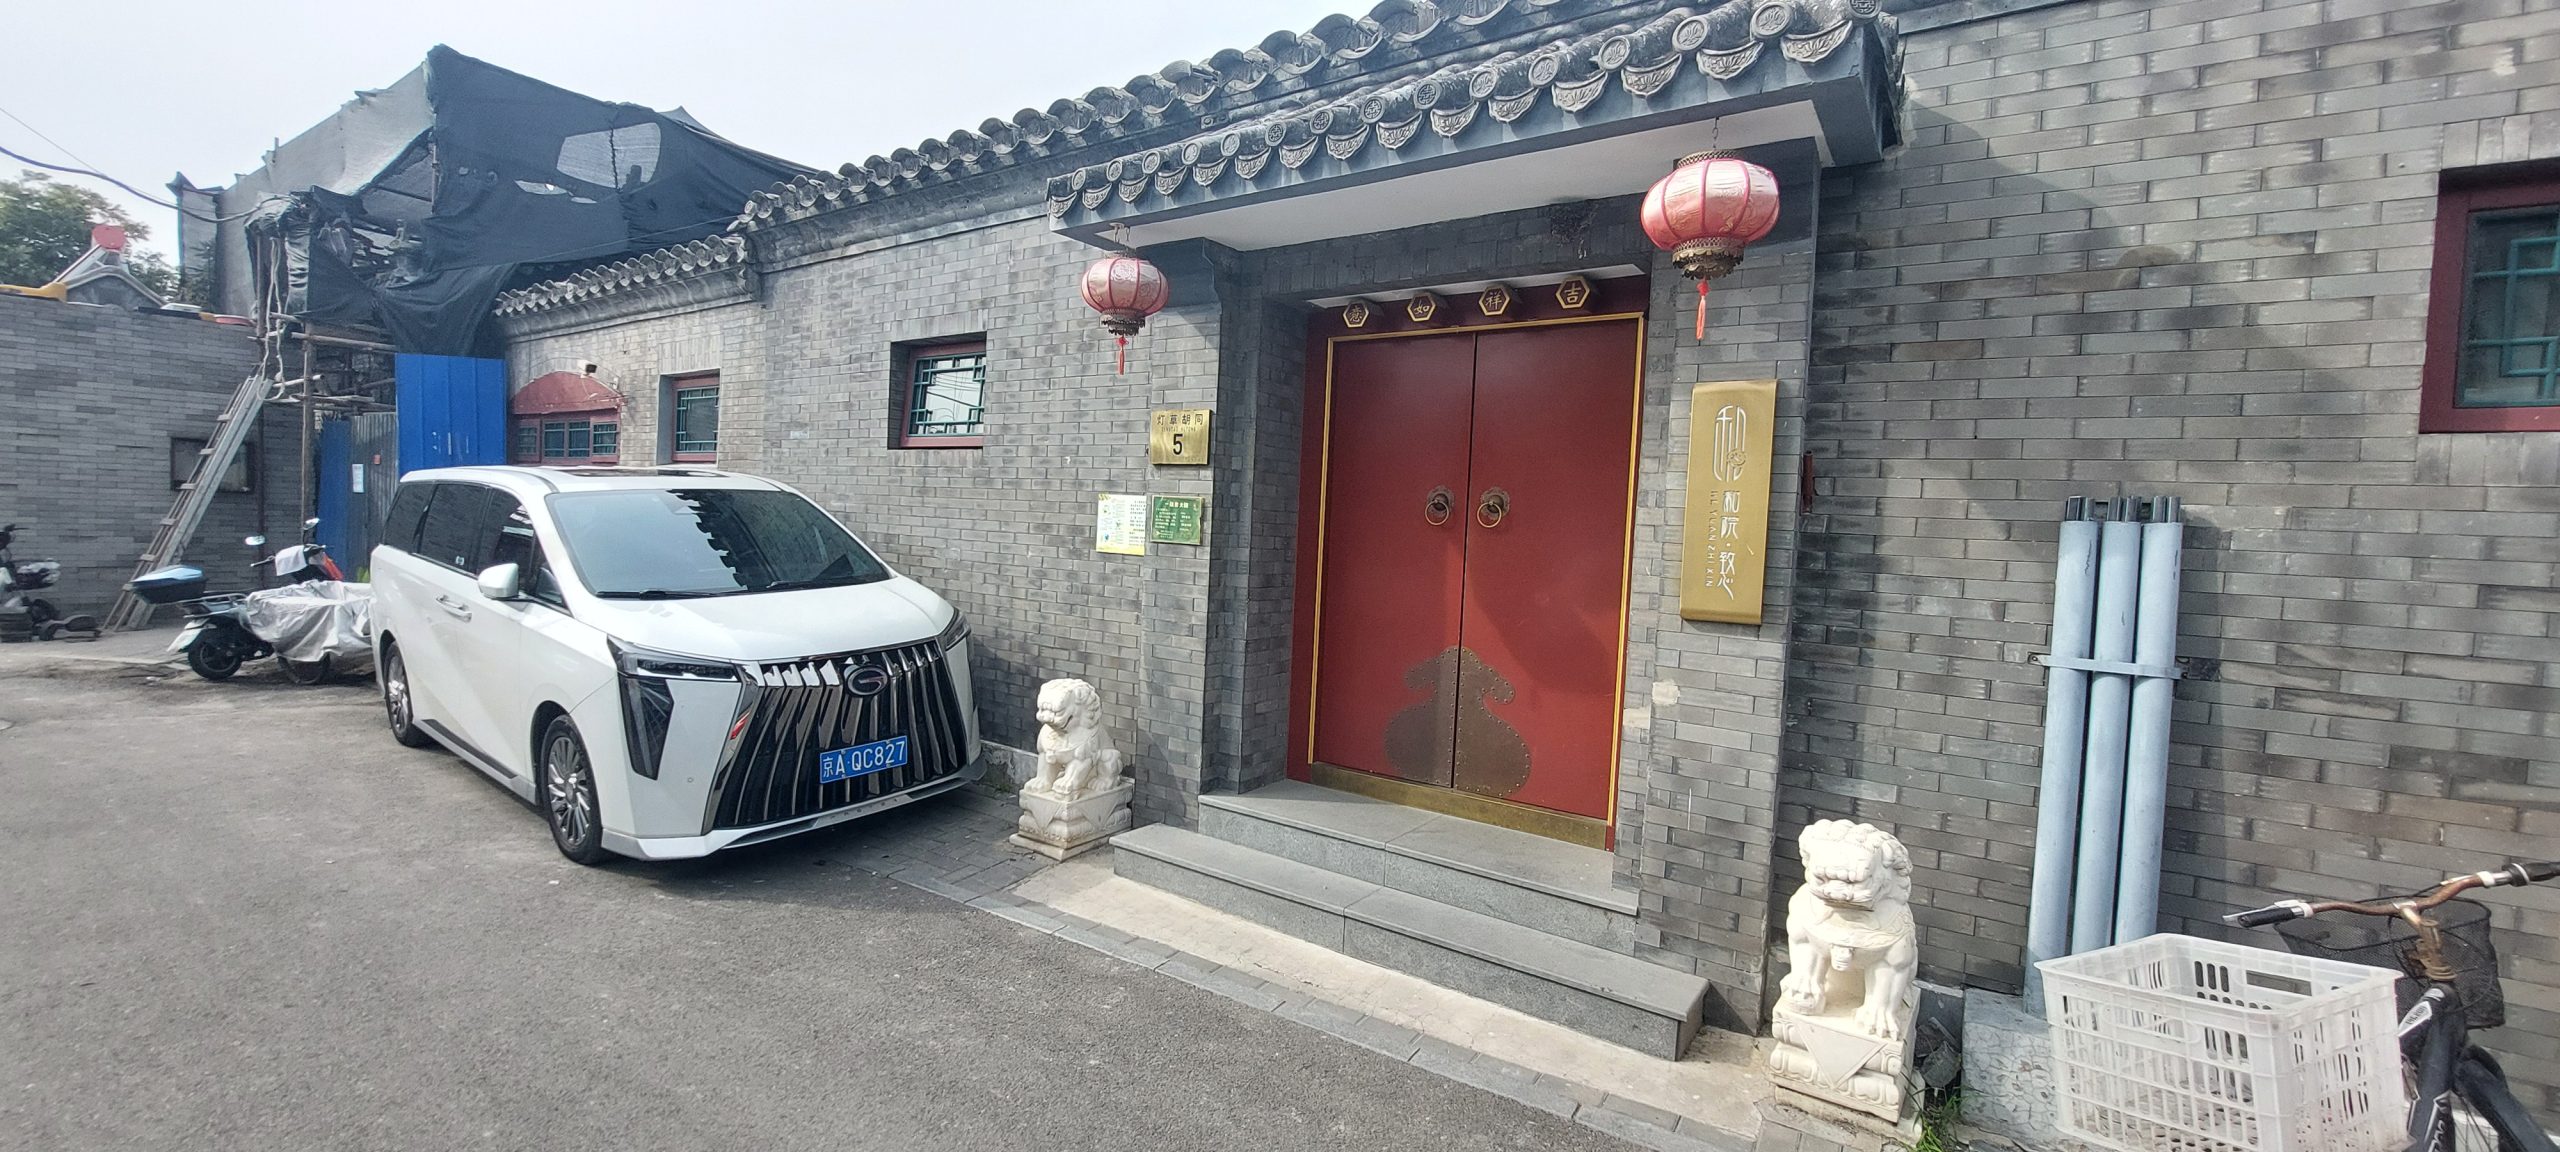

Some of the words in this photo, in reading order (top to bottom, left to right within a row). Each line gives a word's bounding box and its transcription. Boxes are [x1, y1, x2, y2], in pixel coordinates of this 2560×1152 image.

[1485, 291, 1502, 310] 祥
[1564, 282, 1582, 303] 吉
[1349, 305, 1363, 322] 意
[1414, 300, 1430, 315] 如
[1157, 413, 1203, 426] 灯草胡同
[1173, 433, 1183, 456] 5
[1707, 544, 1716, 564] ZHI
[1705, 567, 1715, 587] XIN
